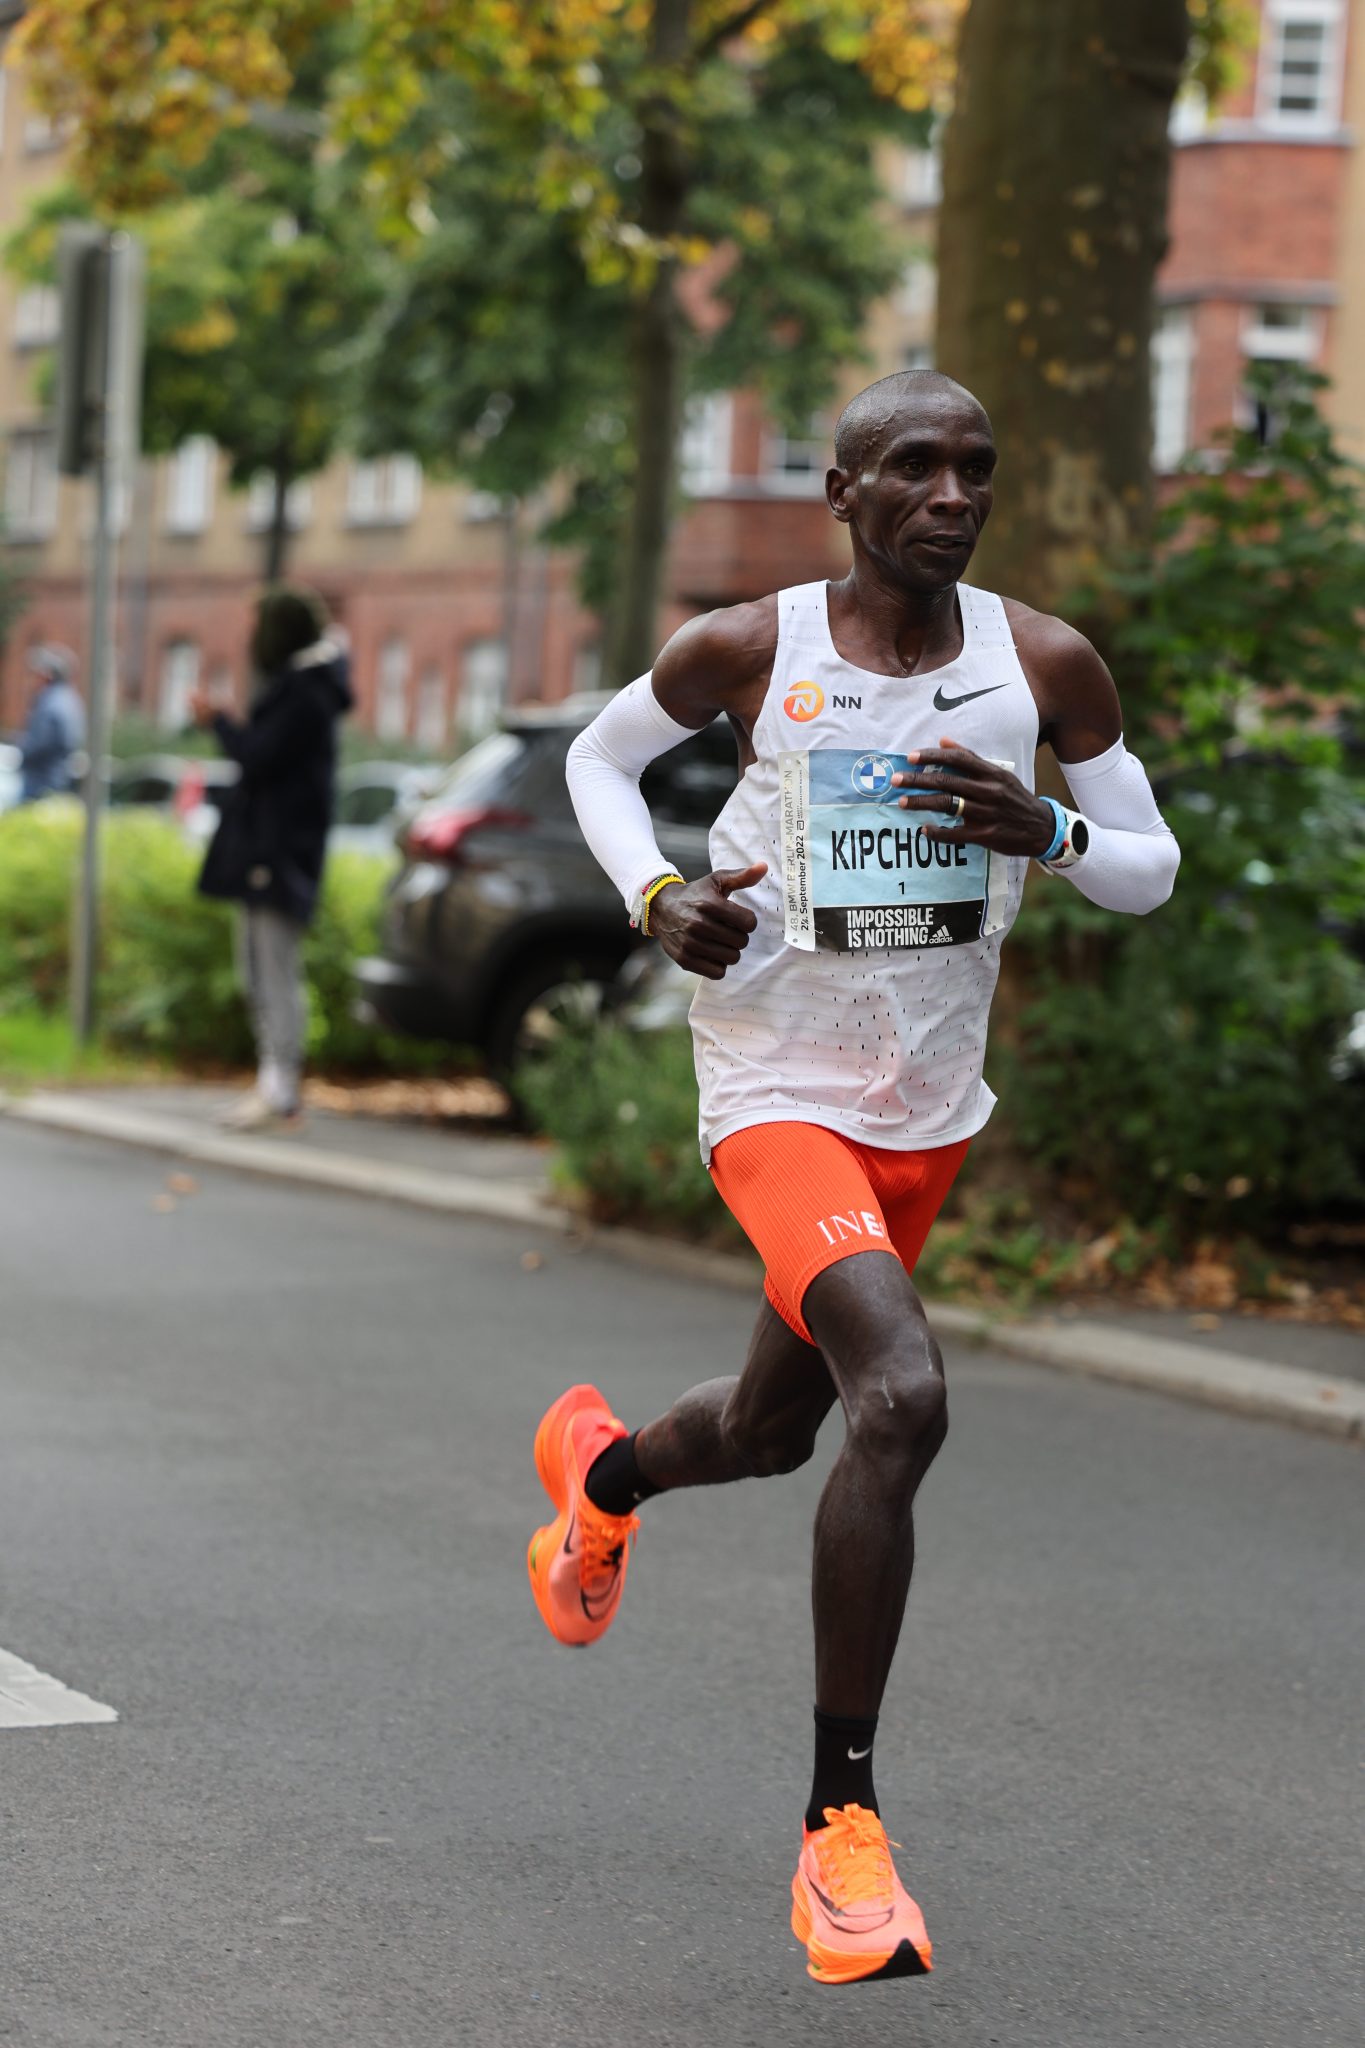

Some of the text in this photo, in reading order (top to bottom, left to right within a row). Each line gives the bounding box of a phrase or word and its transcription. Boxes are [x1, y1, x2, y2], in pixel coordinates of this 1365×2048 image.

[832, 695, 862, 710] NN
[795, 835, 806, 860] 2022
[831, 826, 968, 871] KIPCHOGE
[787, 884, 798, 912] BMW
[798, 861, 808, 914] September
[898, 881, 905, 895] 1
[790, 914, 799, 932] 48.
[847, 907, 934, 929] IMPOSSIBLE
[847, 926, 929, 948] IS NOTHING
[816, 1210, 885, 1246] INE
